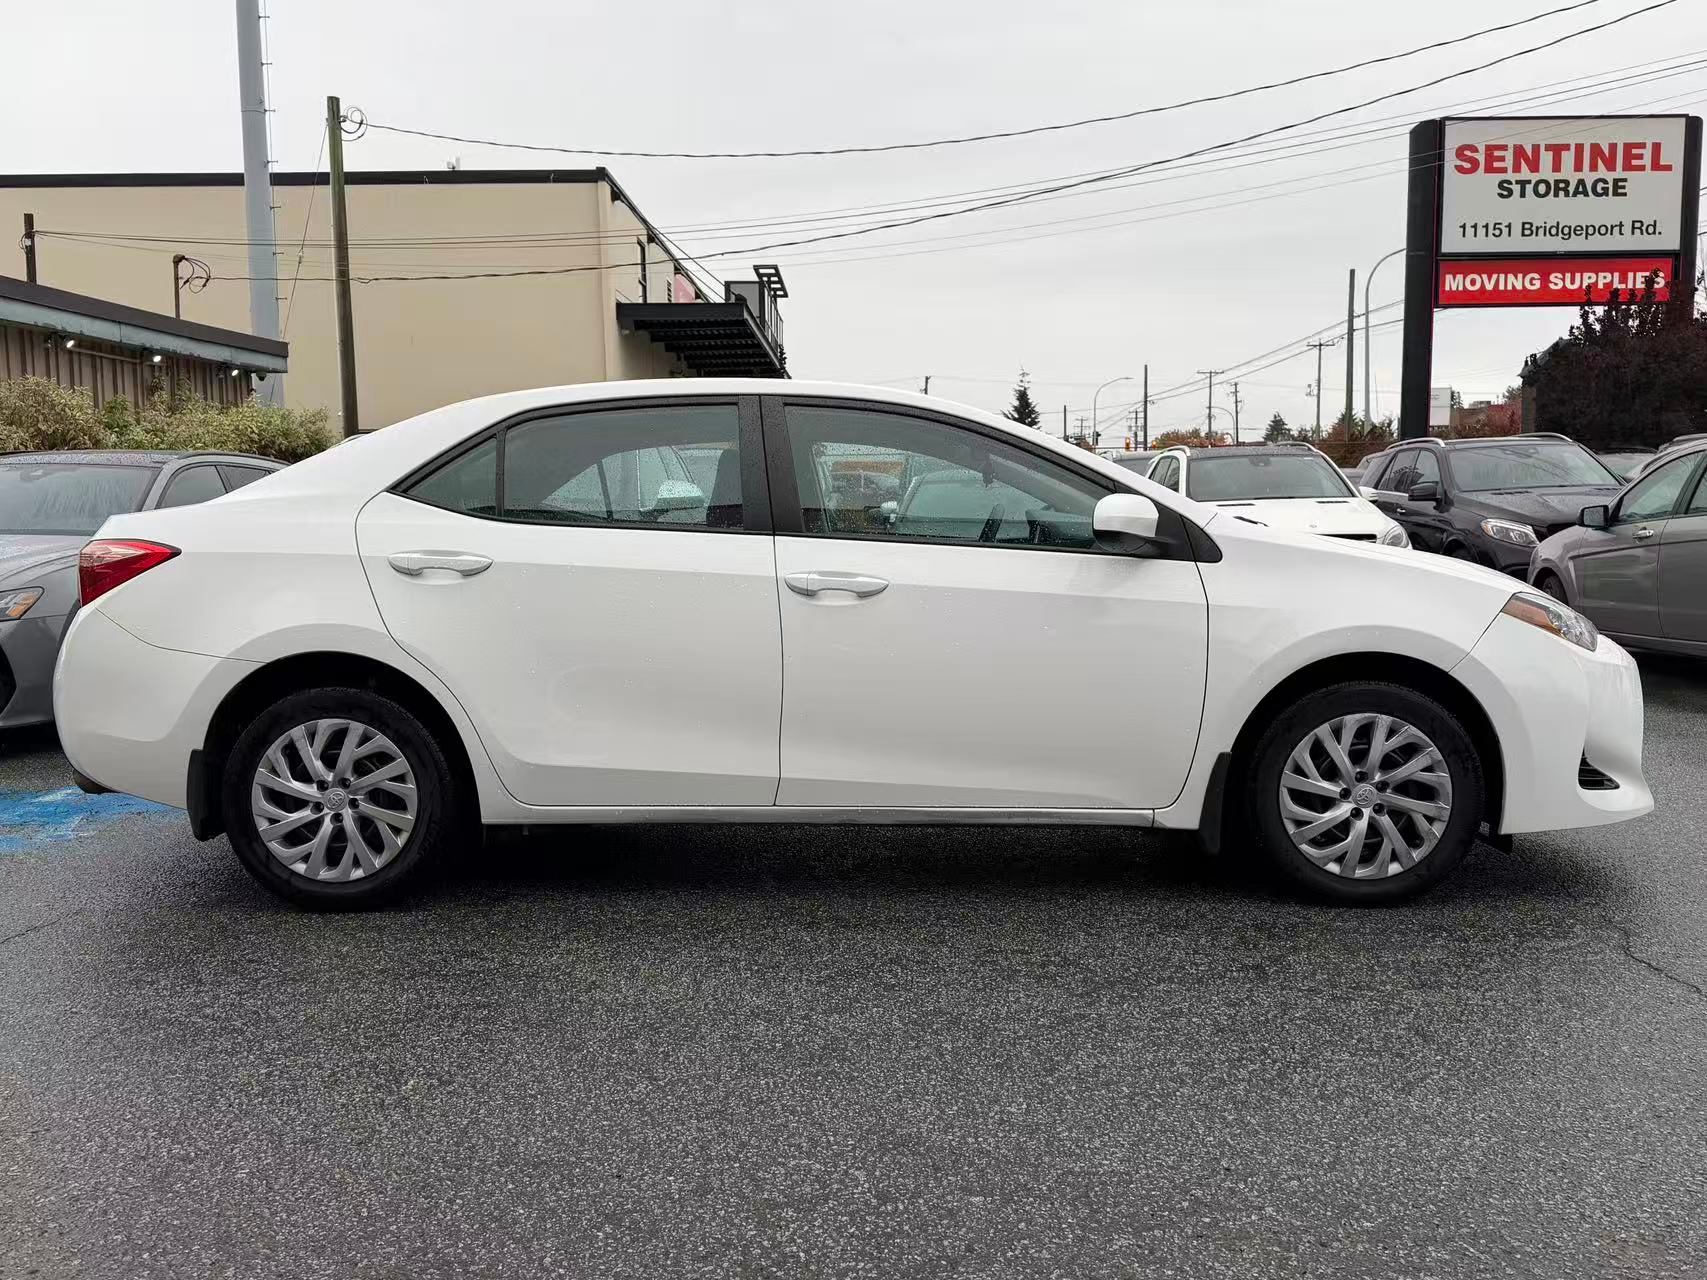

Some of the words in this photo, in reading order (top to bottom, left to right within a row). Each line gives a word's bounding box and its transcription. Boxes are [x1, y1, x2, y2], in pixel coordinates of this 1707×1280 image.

[1454, 142, 1673, 175] SENTINEL
[1497, 178, 1628, 199] STORAGE
[1458, 222, 1513, 238] 11151
[1521, 220, 1625, 241] Bridgeport
[1631, 220, 1663, 236] Rd.
[1445, 273, 1541, 291] MOVING
